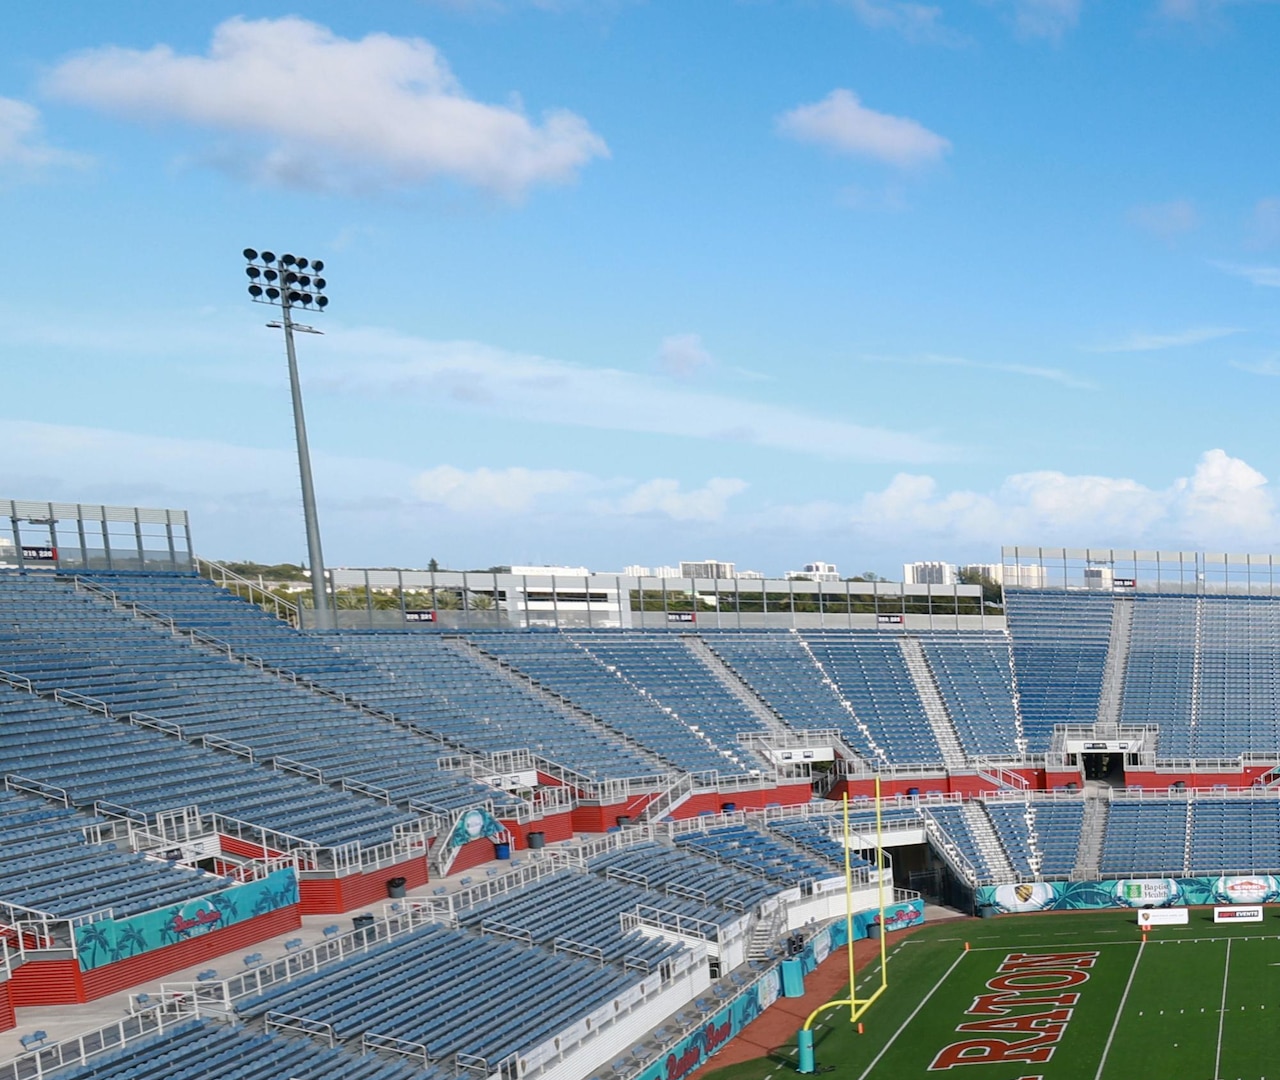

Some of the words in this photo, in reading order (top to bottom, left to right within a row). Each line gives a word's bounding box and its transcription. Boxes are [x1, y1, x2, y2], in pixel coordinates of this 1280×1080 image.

[1143, 884, 1169, 893] Baptist
[1143, 891, 1168, 899] Health
[927, 951, 1100, 1072] RATON
